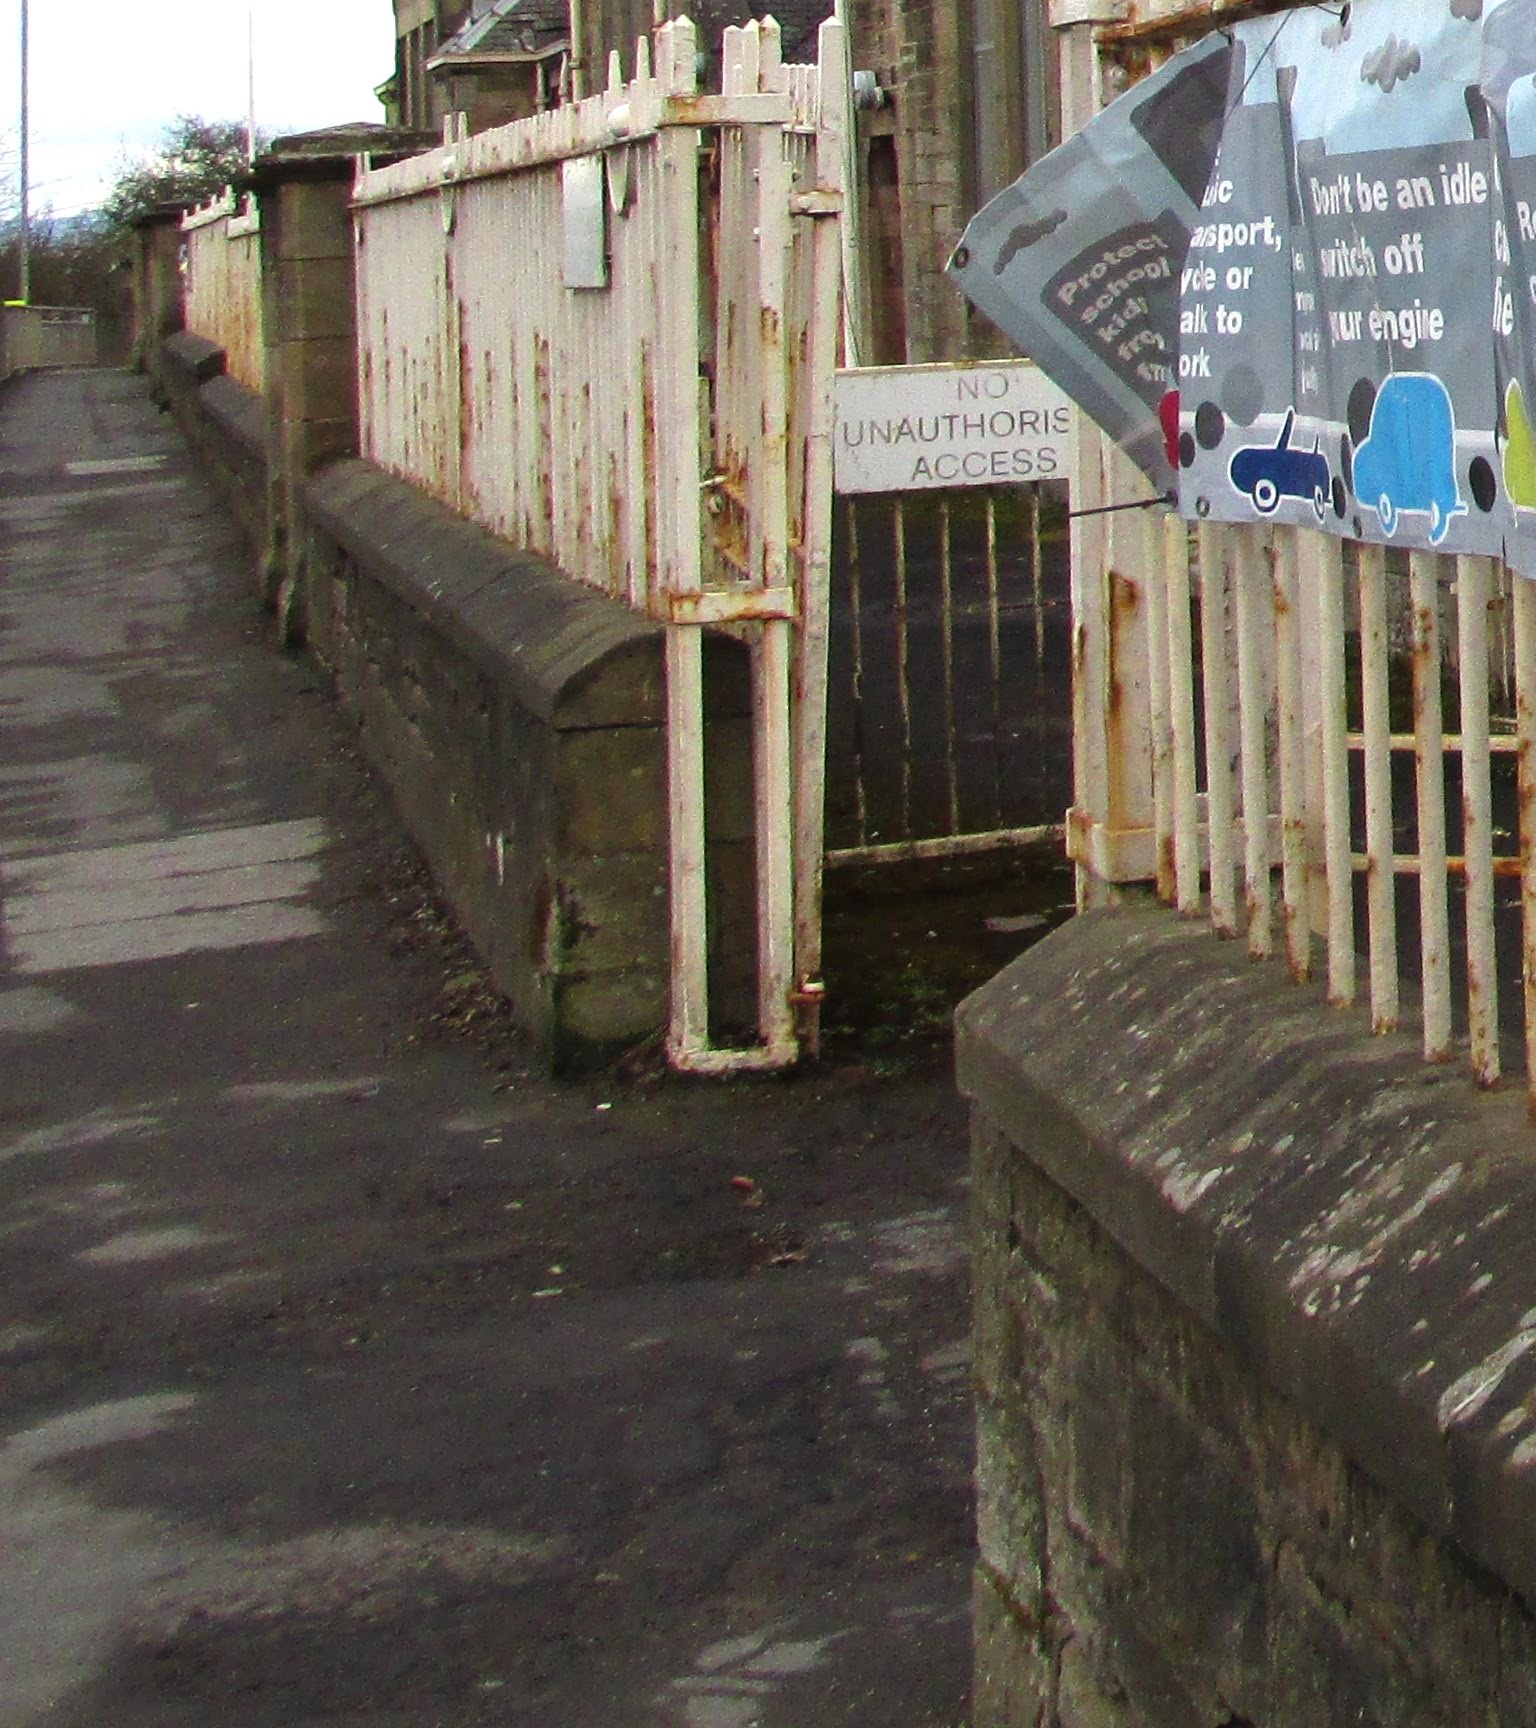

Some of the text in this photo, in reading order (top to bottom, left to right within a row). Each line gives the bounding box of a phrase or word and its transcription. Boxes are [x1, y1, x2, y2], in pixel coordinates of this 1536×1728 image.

[1356, 172, 1389, 213] be
[1396, 175, 1436, 210] an
[1439, 162, 1488, 206] idle
[1057, 234, 1169, 306] Protect
[1320, 236, 1378, 278] witch
[1384, 231, 1425, 275] off
[1081, 255, 1171, 324] school
[1225, 265, 1254, 291] or
[1180, 302, 1244, 335] alk to
[1178, 346, 1212, 378] ork
[957, 372, 1009, 401] NO
[910, 446, 1058, 482] ACCESS
